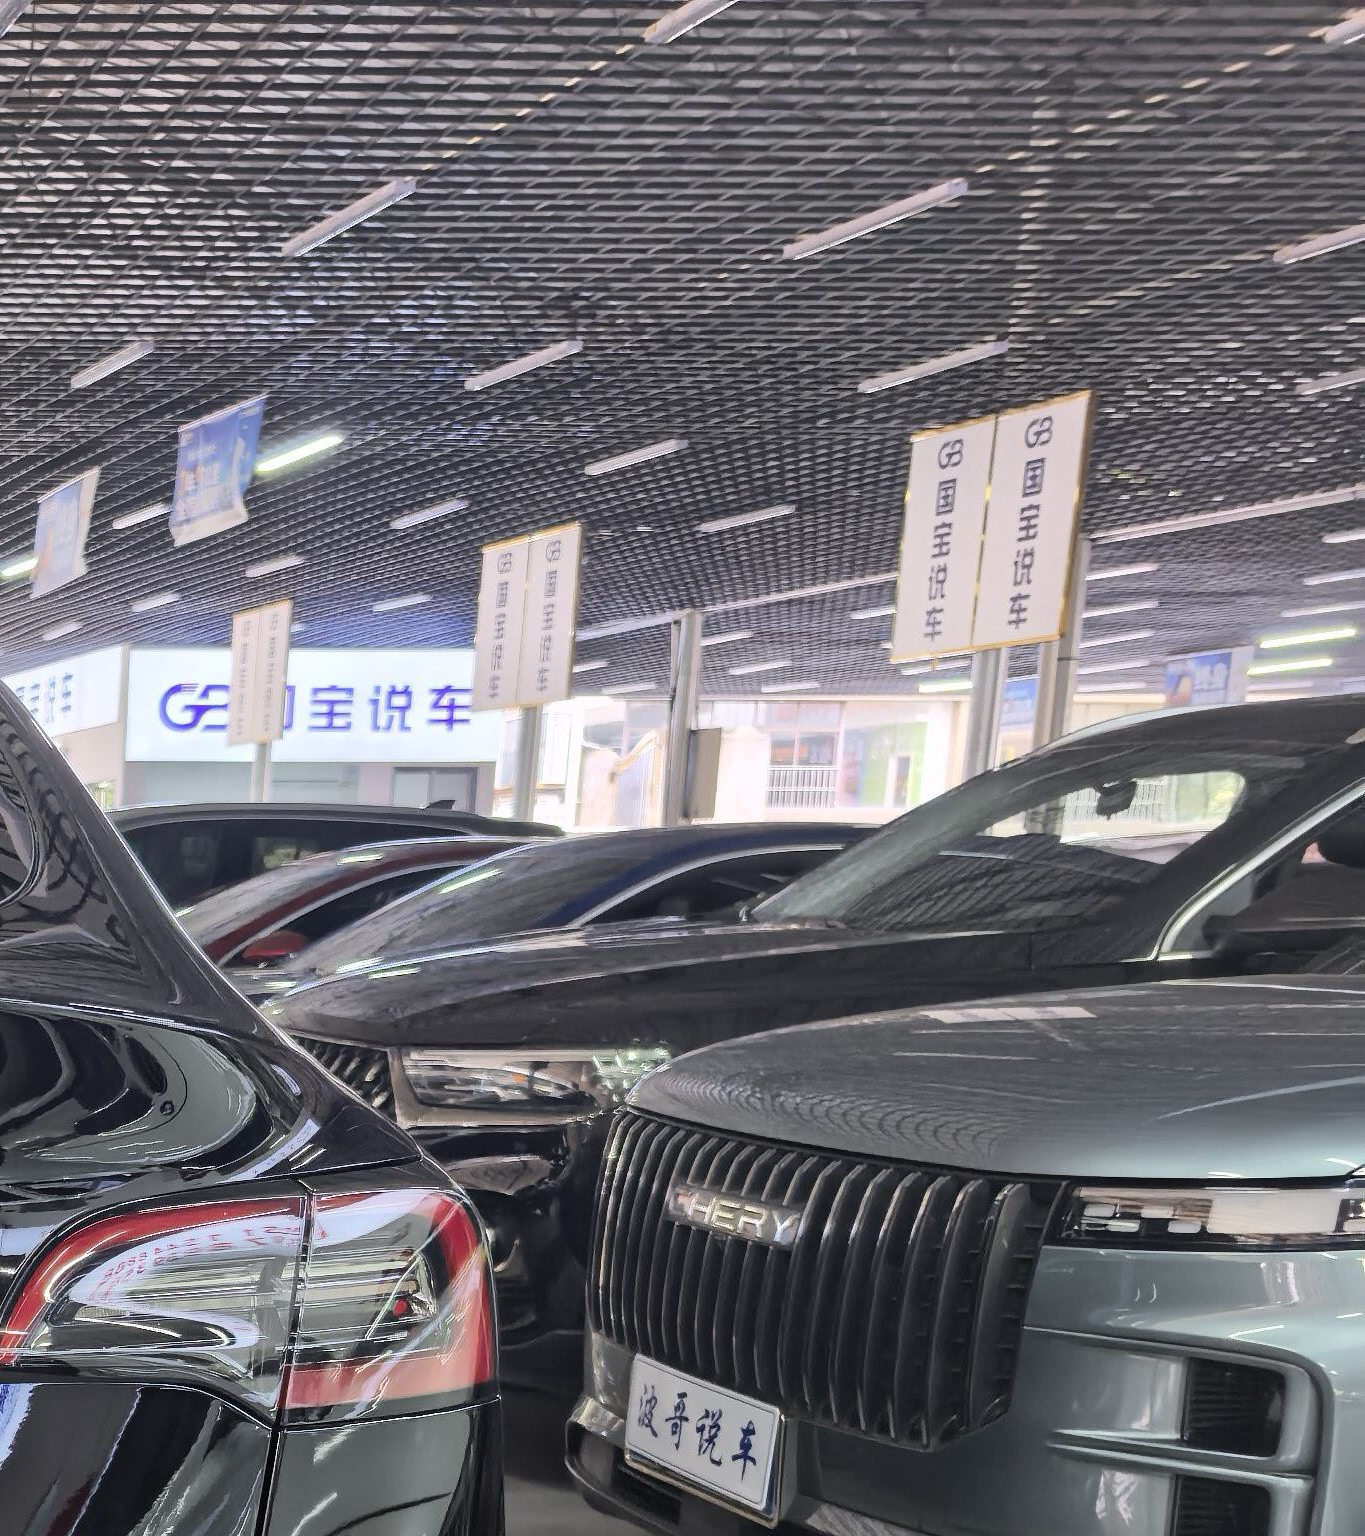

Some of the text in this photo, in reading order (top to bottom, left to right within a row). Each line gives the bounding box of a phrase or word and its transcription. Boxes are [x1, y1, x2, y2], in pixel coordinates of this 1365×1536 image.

[923, 478, 957, 641] 国宝说车
[1007, 457, 1045, 629] 国宝说车
[283, 684, 472, 732] 宝说车
[637, 1384, 757, 1482] 波哥说车
